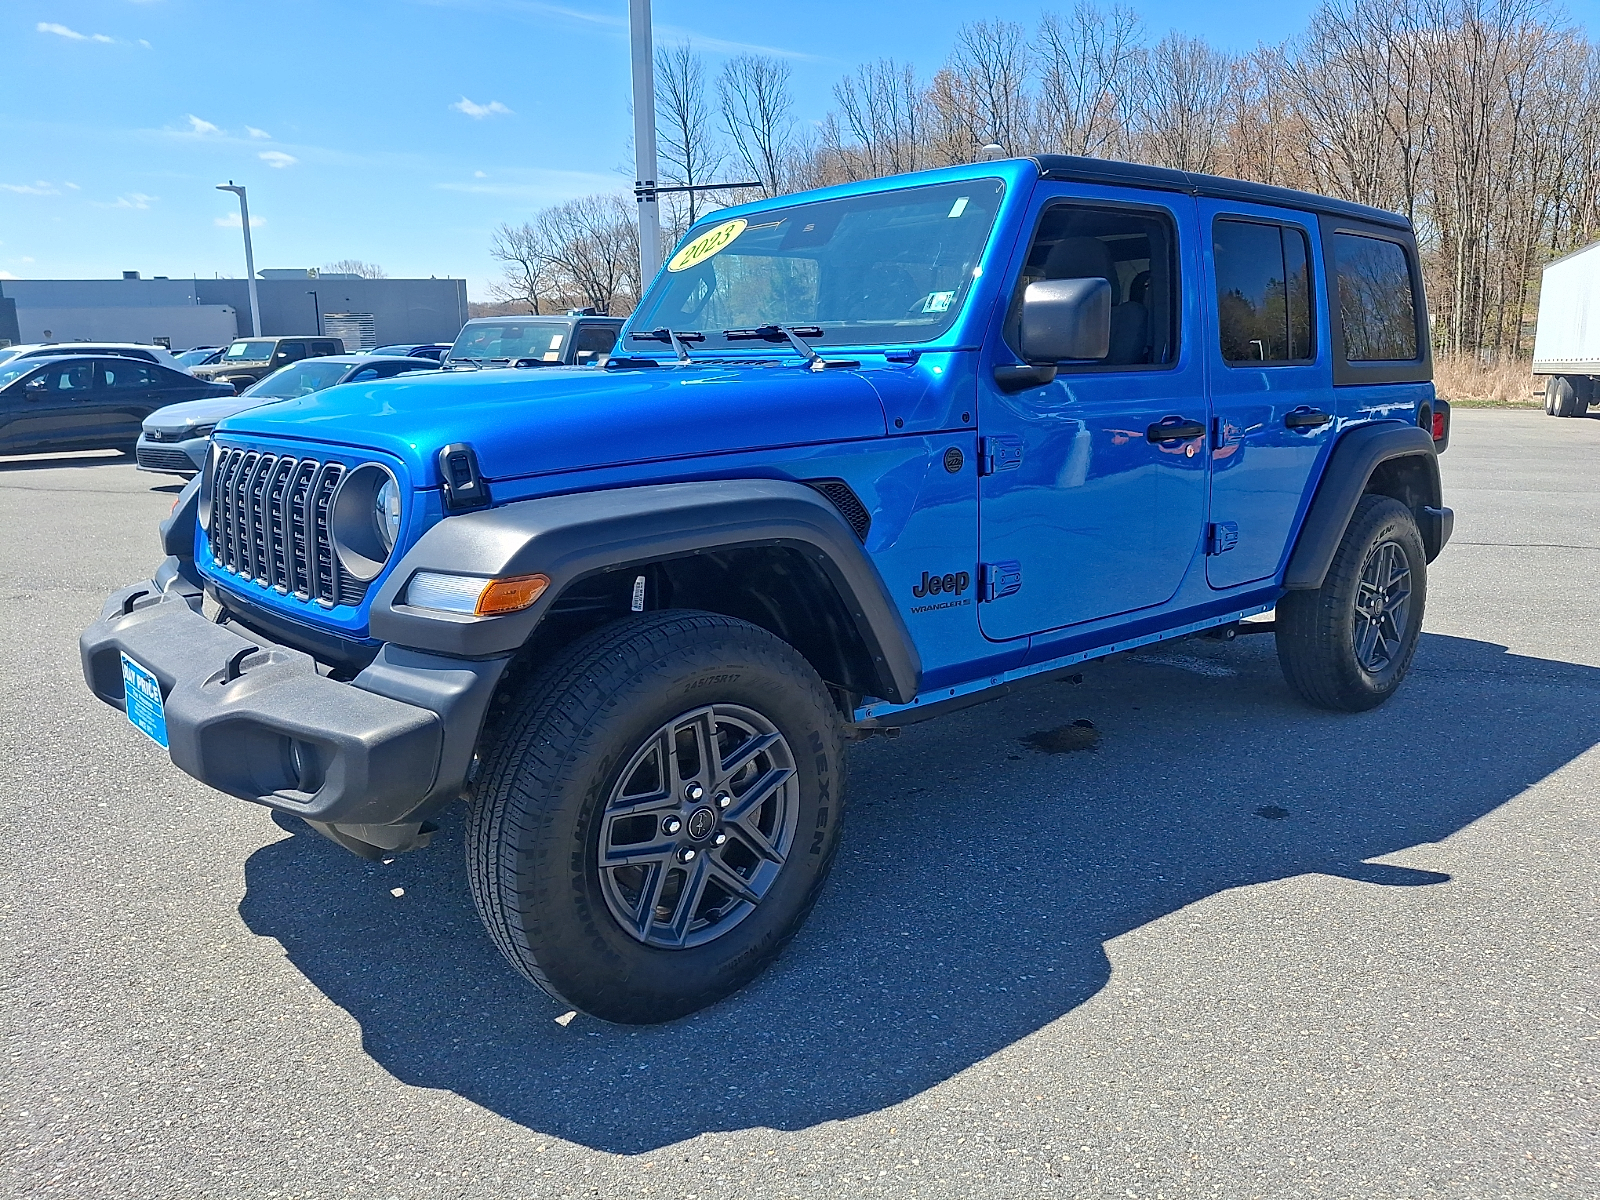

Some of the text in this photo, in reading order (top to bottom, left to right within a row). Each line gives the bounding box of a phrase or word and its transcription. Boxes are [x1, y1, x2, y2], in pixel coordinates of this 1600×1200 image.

[678, 224, 736, 268] 2023
[912, 570, 970, 598] Jeep
[910, 600, 962, 614] WRANGLER
[136, 673, 160, 703] PRICE
[684, 674, 741, 693] 245/75R17
[807, 730, 830, 856] NEXEN
